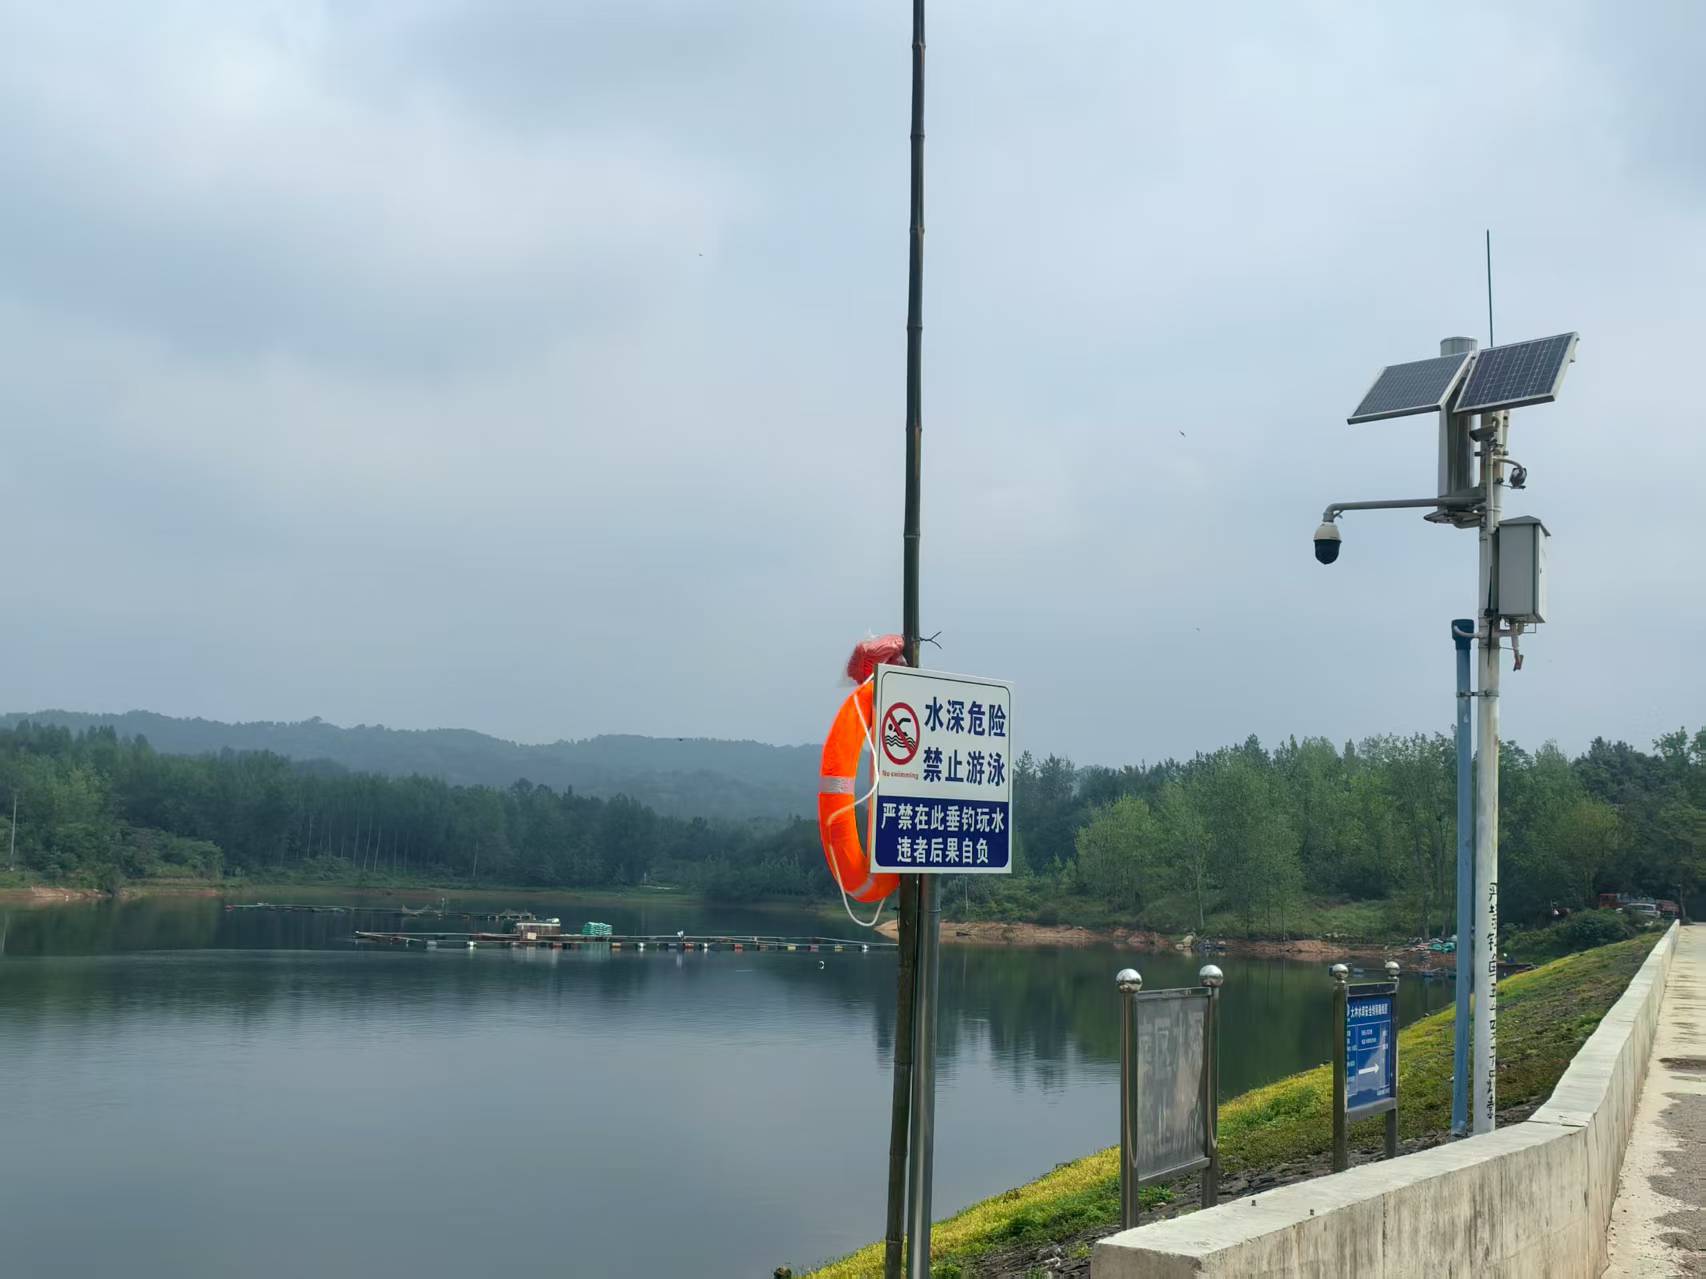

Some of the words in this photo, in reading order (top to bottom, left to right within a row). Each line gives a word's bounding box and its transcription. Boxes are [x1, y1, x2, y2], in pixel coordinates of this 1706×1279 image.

[924, 696, 1006, 737] 水深危险
[923, 746, 1005, 787] 禁止游泳
[881, 802, 1005, 833] 严禁在此垂钓玩水
[897, 836, 989, 865] 违者后果自负
